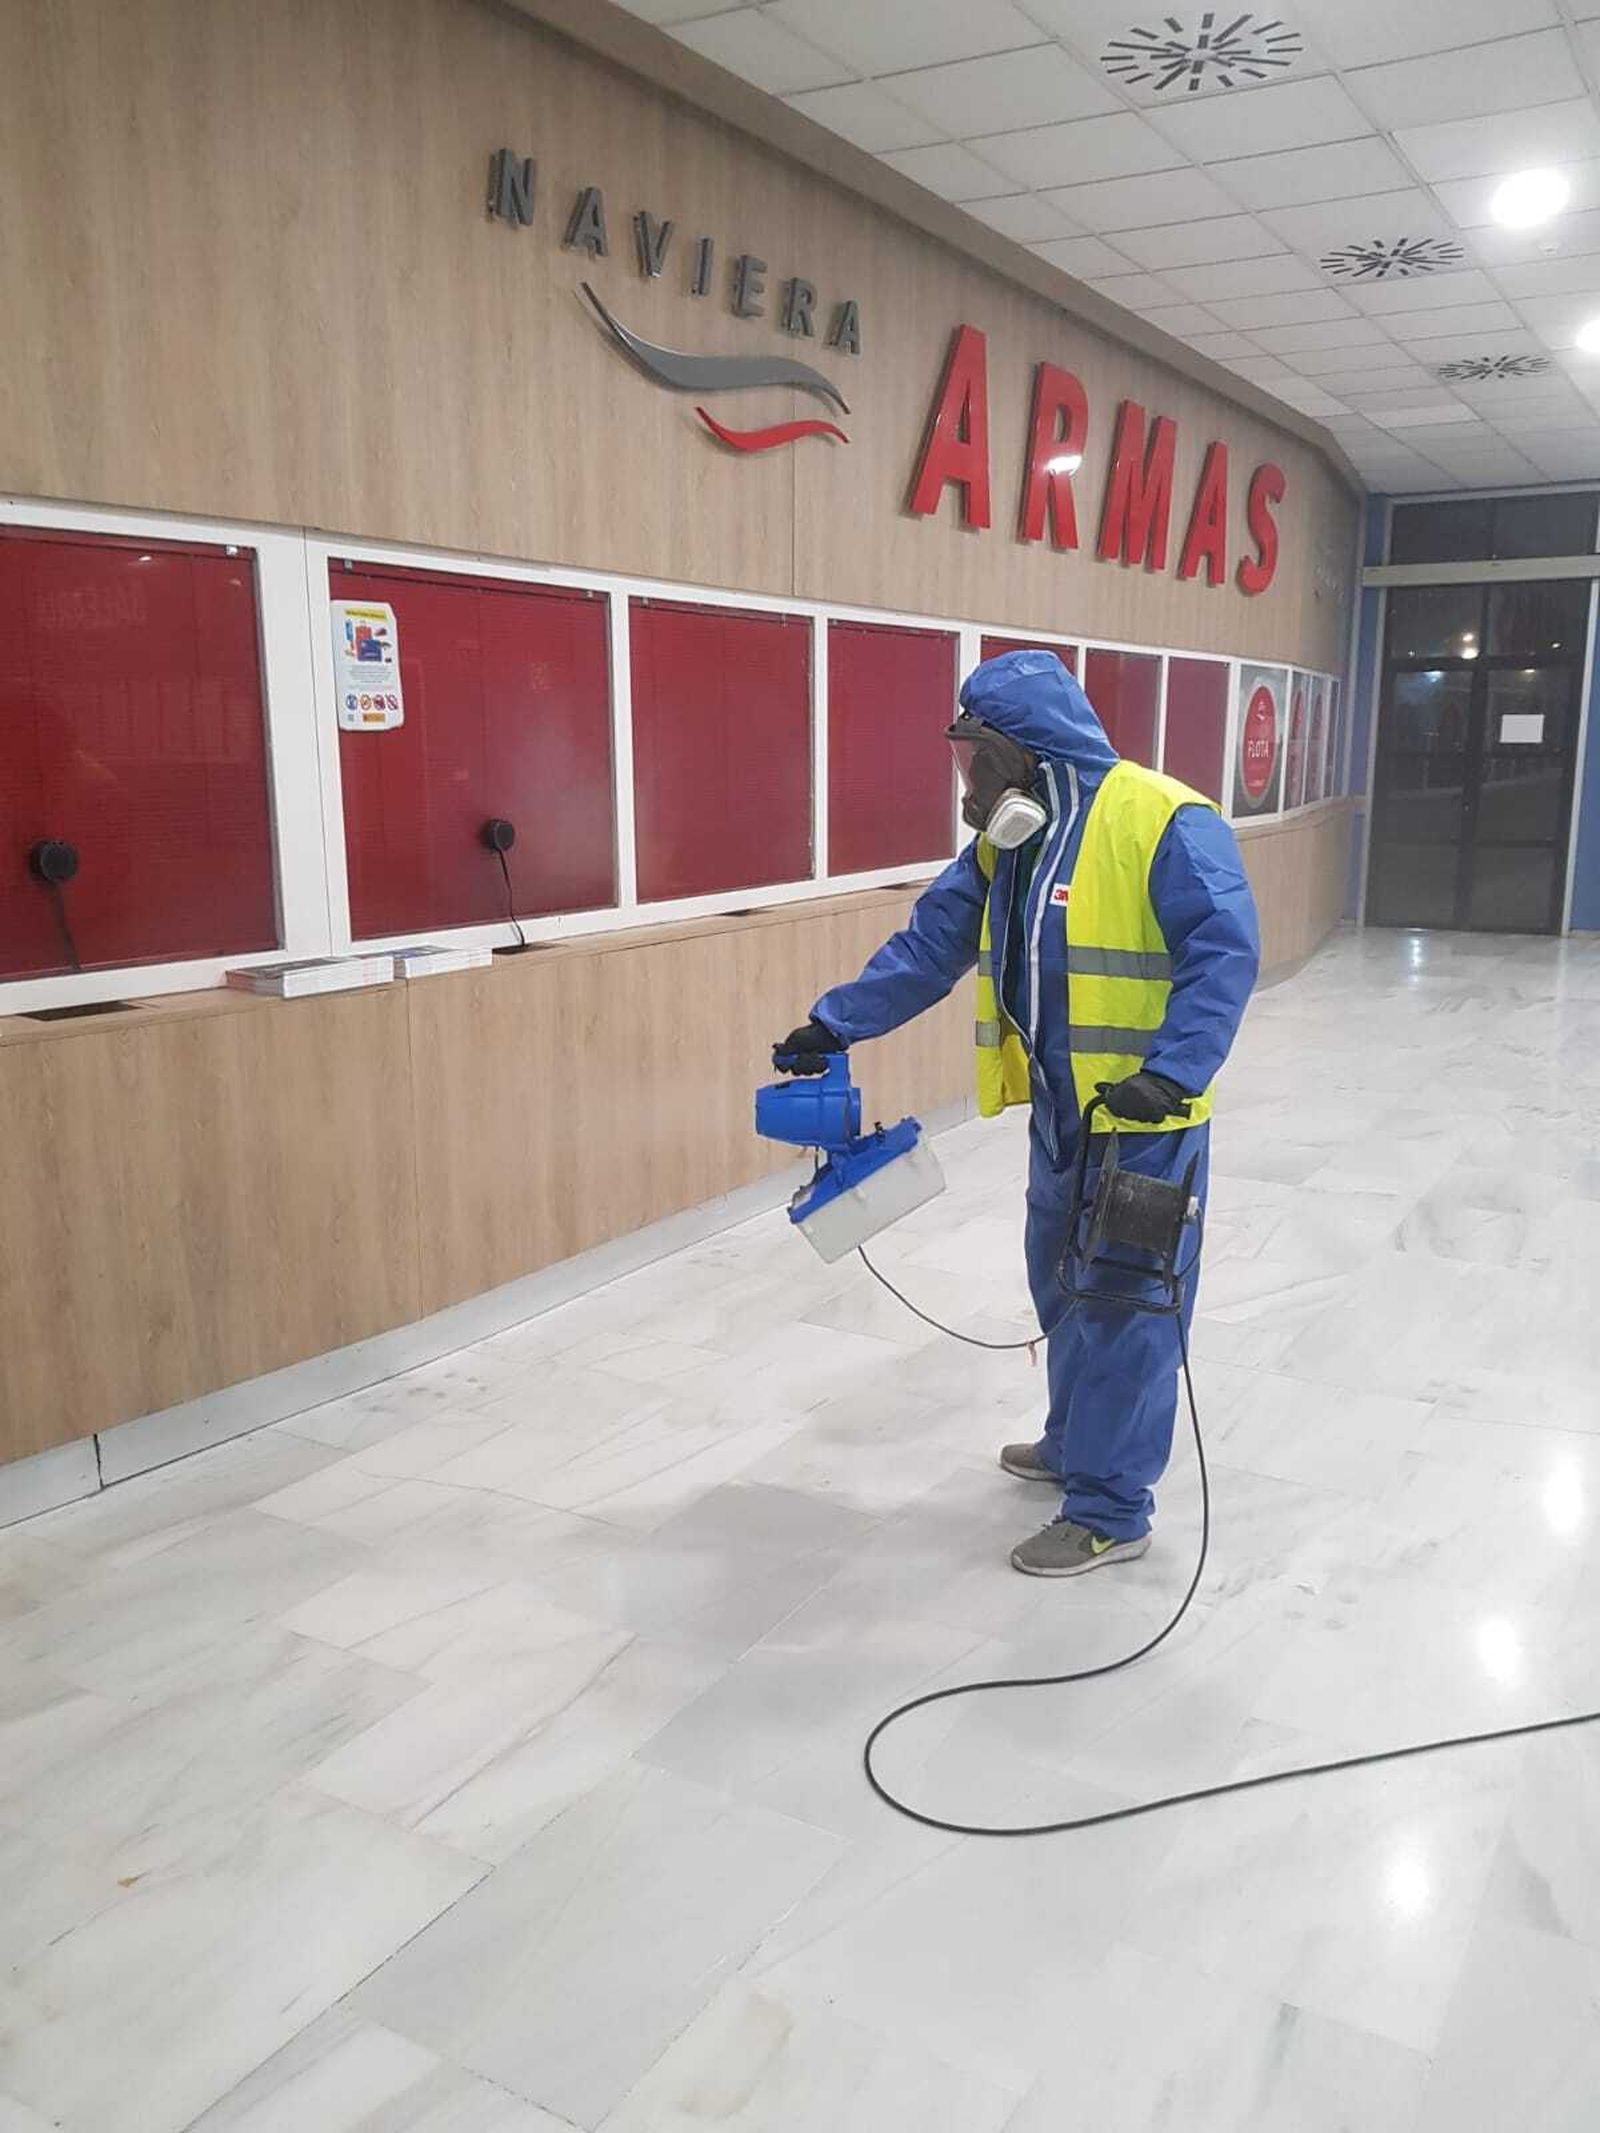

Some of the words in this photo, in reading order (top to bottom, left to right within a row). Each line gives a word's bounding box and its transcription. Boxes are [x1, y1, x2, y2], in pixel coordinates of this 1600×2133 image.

[488, 148, 862, 355] NAVIERA
[911, 324, 1286, 595] ARMAS
[1248, 739, 1269, 758] FLOTA
